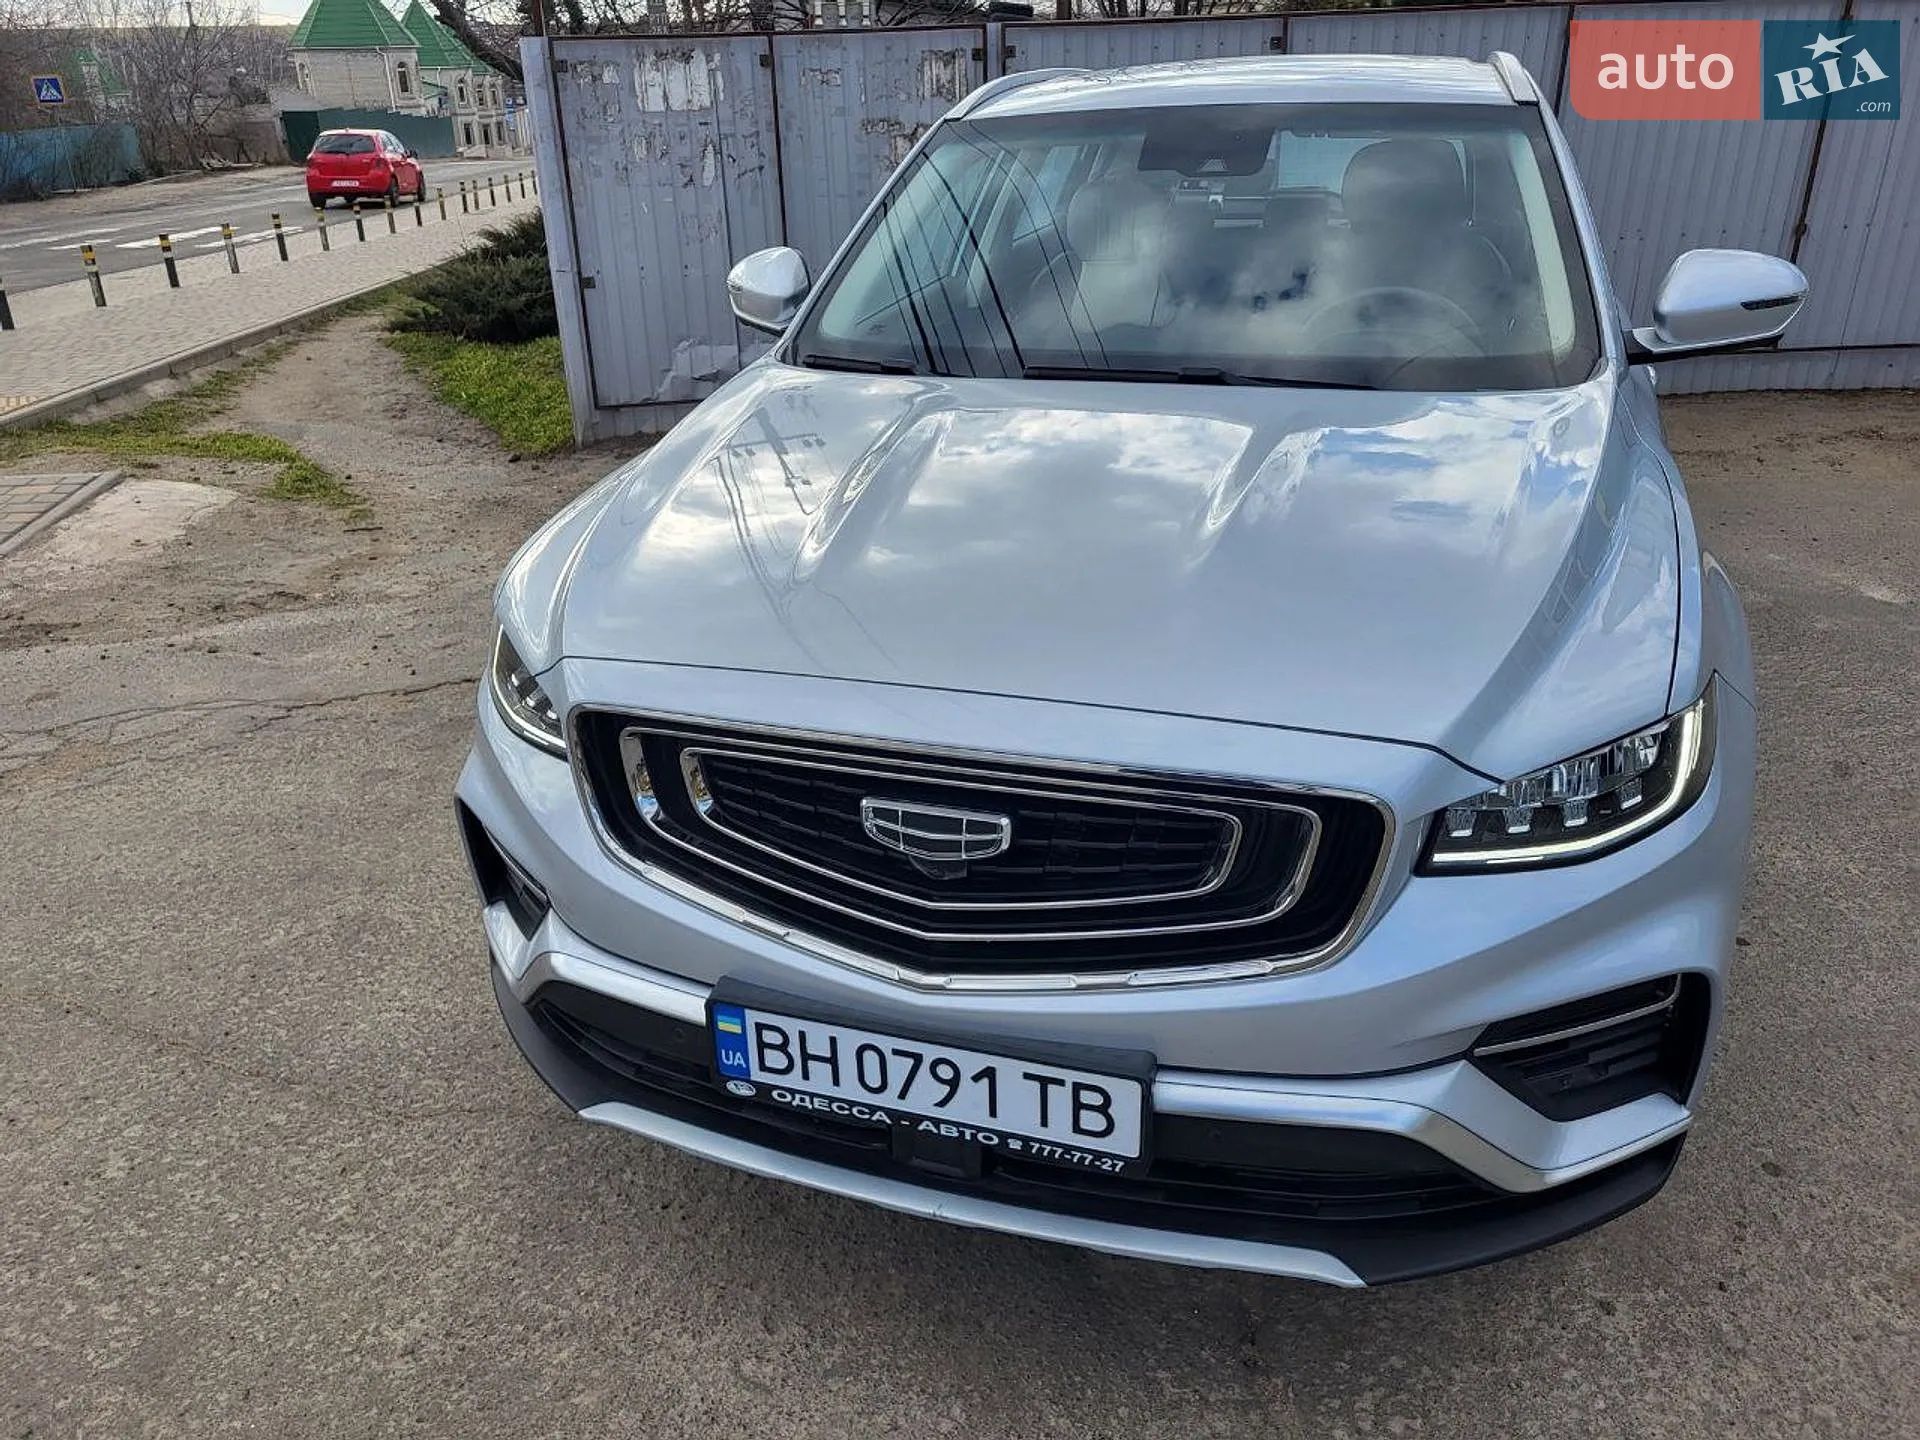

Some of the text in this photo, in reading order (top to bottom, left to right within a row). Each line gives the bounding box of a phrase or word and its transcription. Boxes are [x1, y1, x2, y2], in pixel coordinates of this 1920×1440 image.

[721, 1049, 747, 1069] UA
[754, 1021, 1116, 1139] BH 0791 TB
[771, 1089, 892, 1124] ОДЕССА
[917, 1120, 999, 1146] АВТО
[1029, 1142, 1125, 1173] 777-77-27
